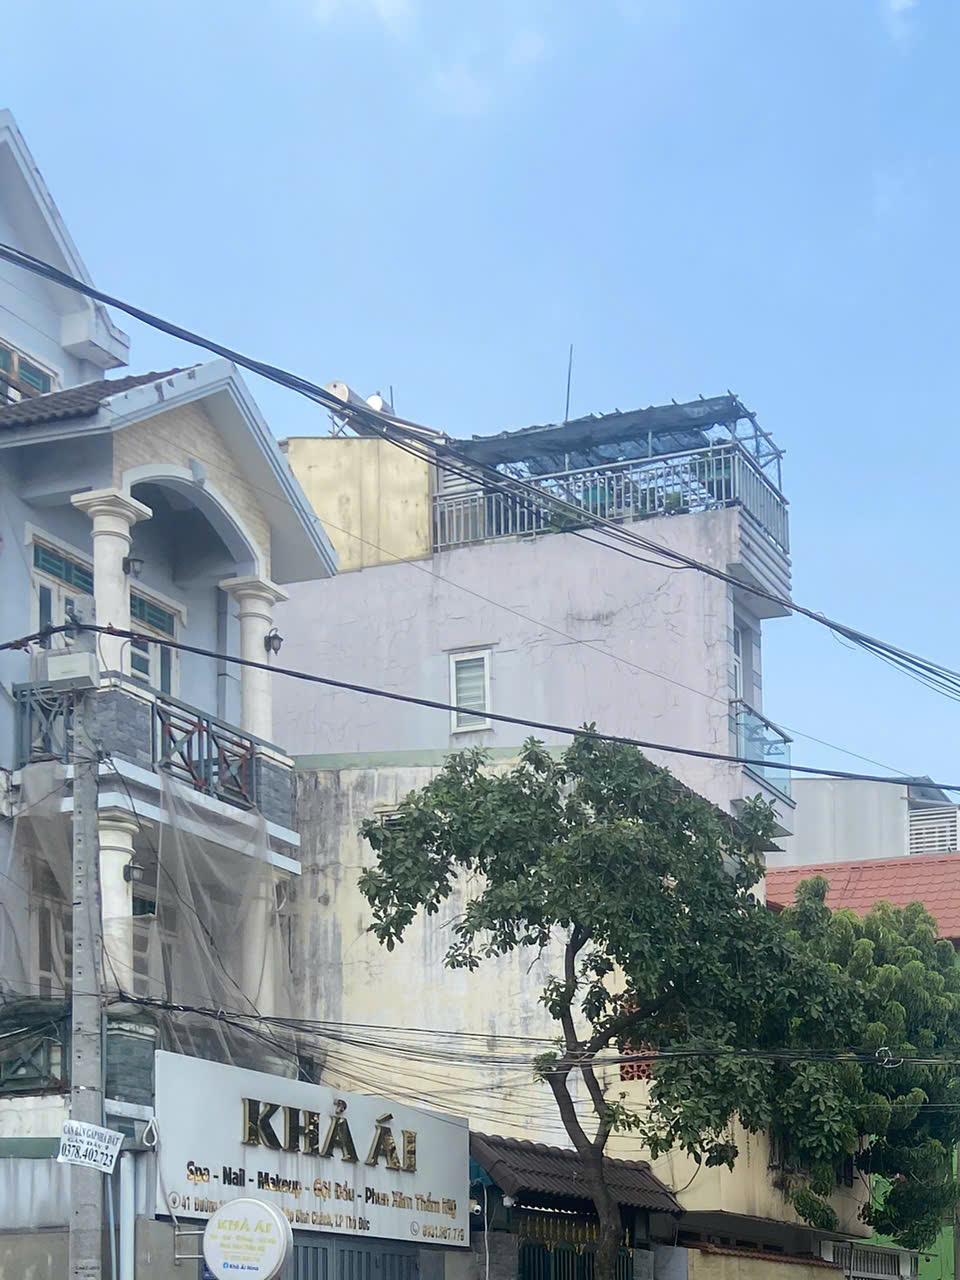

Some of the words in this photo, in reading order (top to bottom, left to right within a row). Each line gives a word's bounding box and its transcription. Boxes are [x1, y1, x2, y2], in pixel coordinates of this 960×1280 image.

[61, 1142, 114, 1168] 0378.402.723
[241, 1096, 360, 1162] KHẢ
[364, 1112, 418, 1172] ÁI
[186, 1160, 210, 1185] Spa
[222, 1166, 246, 1187] Nail
[257, 1171, 302, 1199] Makeup
[365, 1186, 390, 1207] Phun
